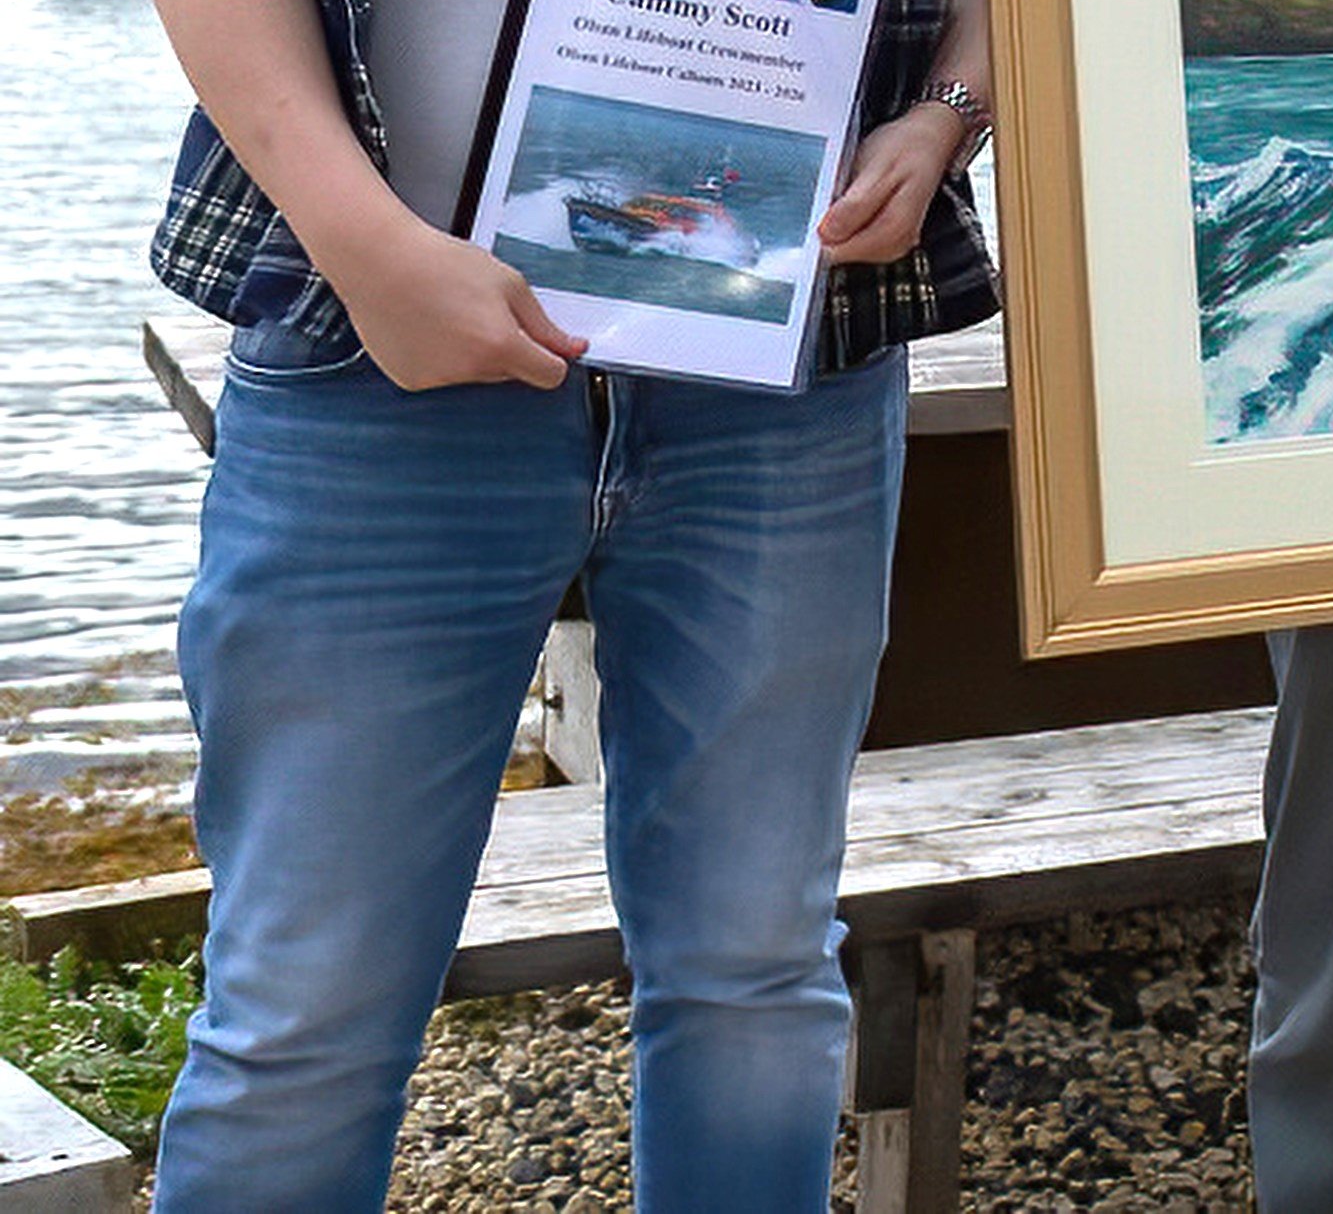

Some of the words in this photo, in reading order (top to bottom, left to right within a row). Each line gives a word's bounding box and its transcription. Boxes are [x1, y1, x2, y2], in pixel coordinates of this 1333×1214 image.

[573, 16, 621, 38] Oban
[624, 25, 693, 50] Lifeboat
[723, 2, 791, 37] Scott
[556, 45, 599, 64] Oban
[602, 53, 664, 75] Lifeboat
